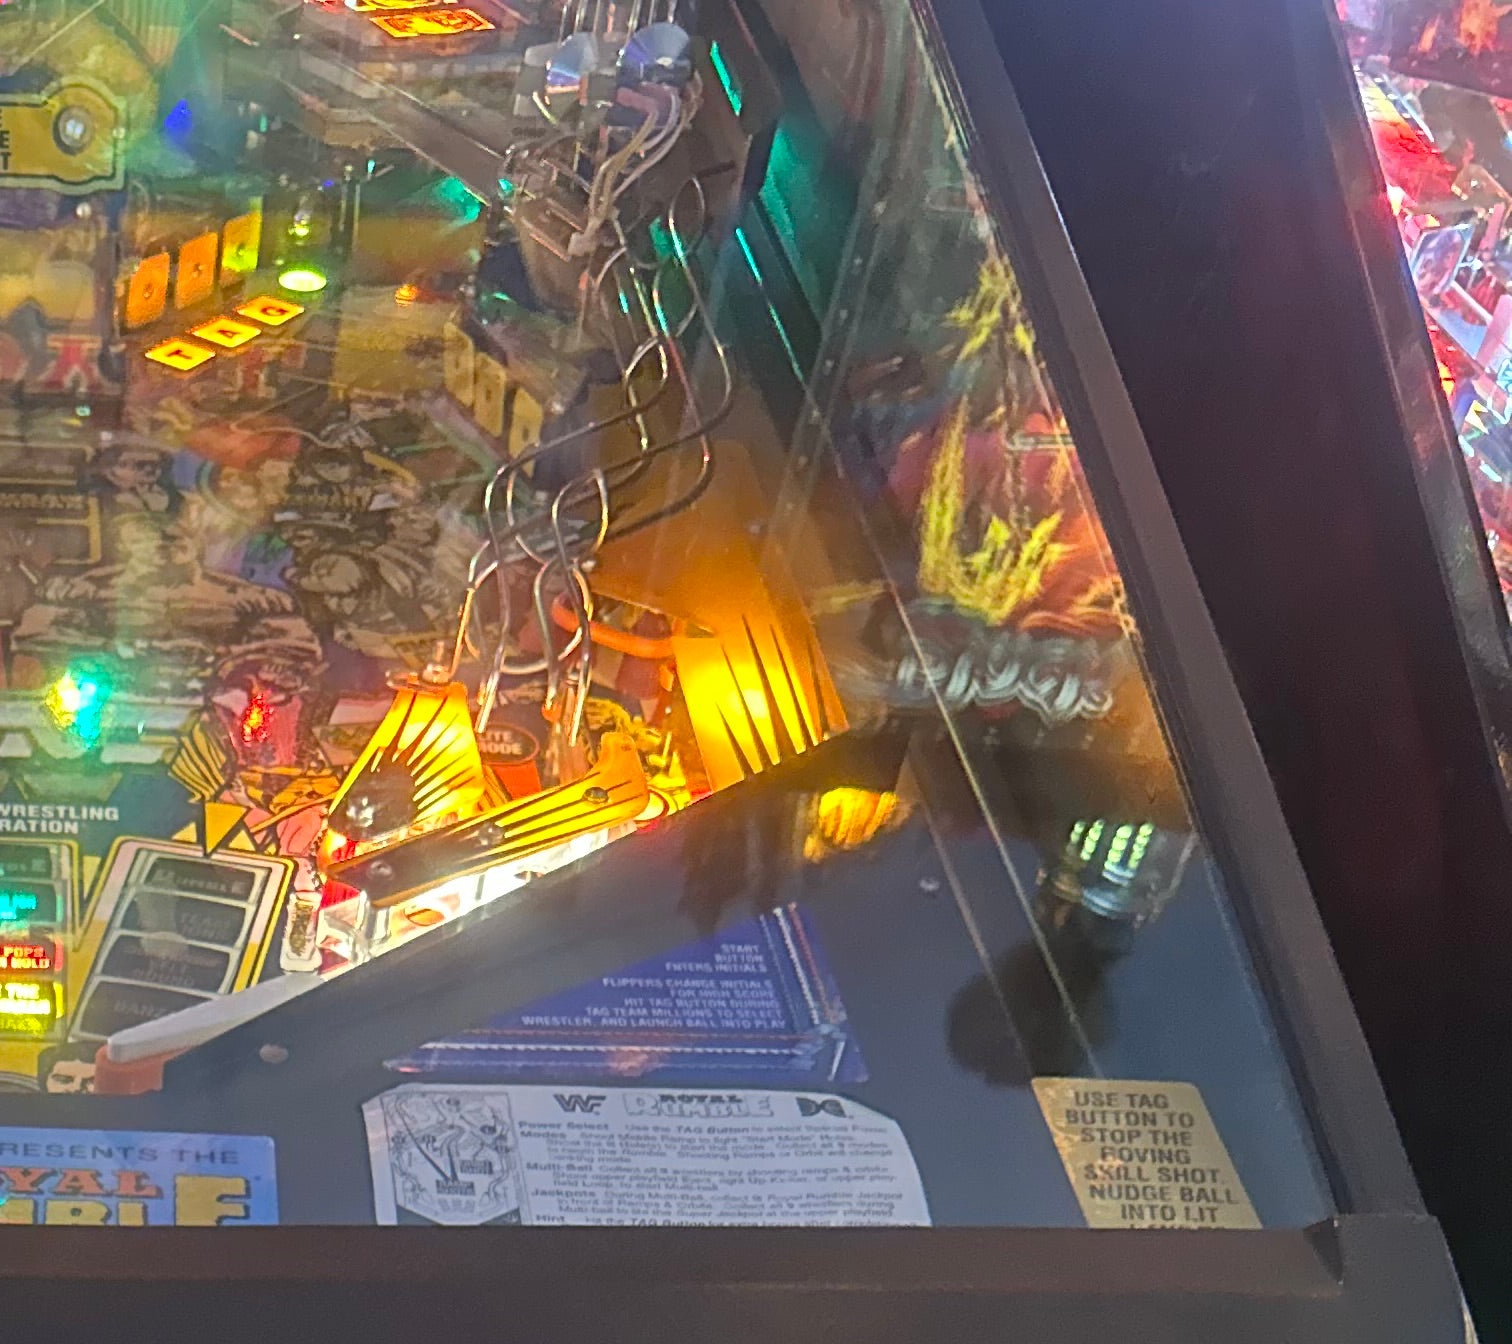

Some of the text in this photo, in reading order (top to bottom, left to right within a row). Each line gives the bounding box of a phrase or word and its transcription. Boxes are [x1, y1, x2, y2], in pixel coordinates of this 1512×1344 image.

[1074, 1091, 1170, 1110] USE TAG
[1065, 1109, 1195, 1129] BUTTON TO
[1080, 1128, 1193, 1146] STOP THE
[170, 1148, 240, 1166] THE
[1084, 1164, 1150, 1182] SKILL
[1088, 1184, 1240, 1205] NUDGE BALL
[1120, 1204, 1219, 1223] INTO LIT
